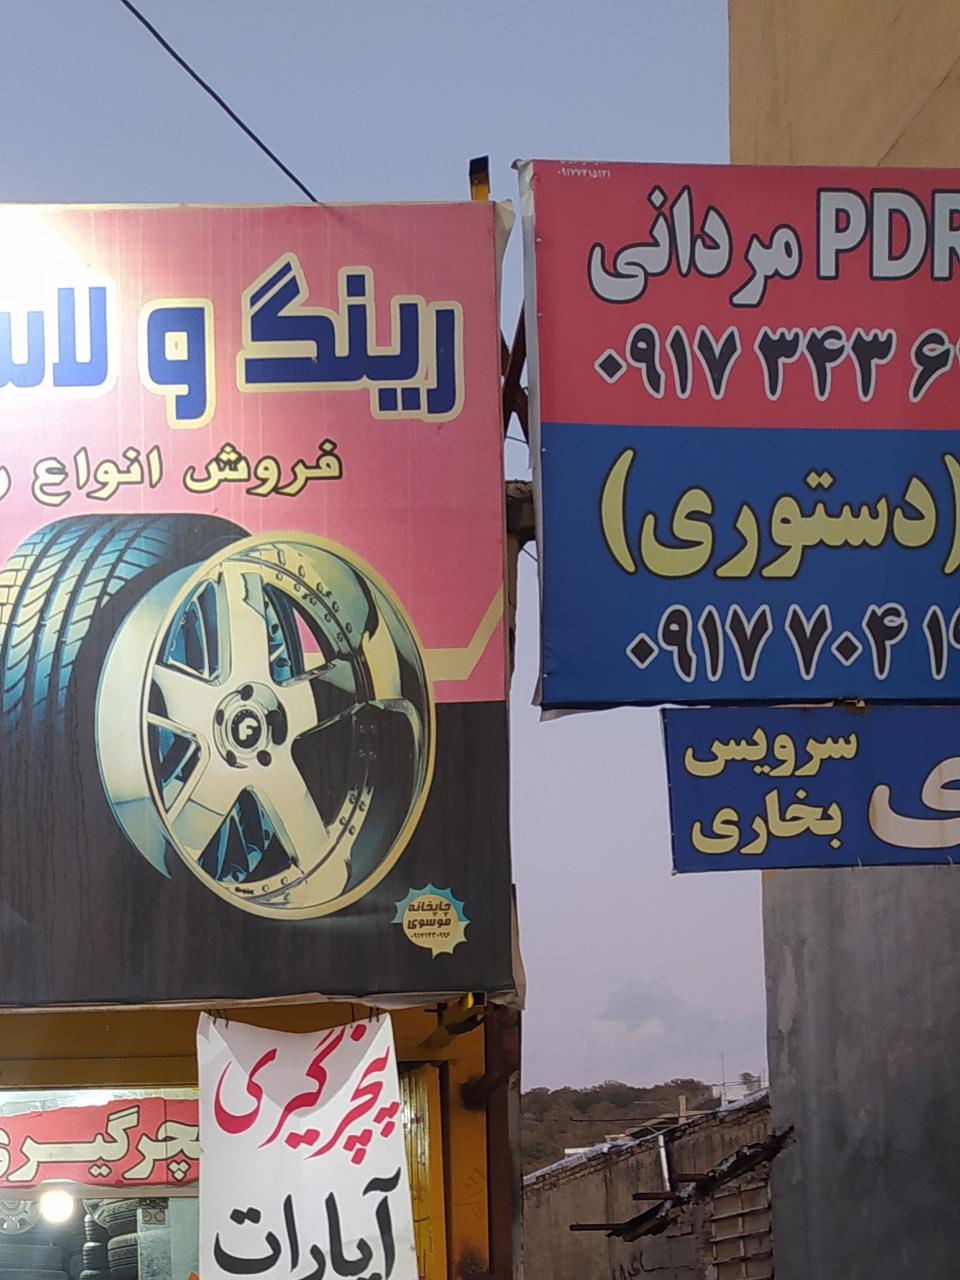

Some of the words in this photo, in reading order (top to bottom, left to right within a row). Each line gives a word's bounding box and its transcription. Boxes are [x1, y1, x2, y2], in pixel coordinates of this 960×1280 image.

[588, 185, 802, 308] مردانی
[145, 303, 210, 423] و
[241, 258, 458, 416] رینگ
[909, 327, 960, 402] ۶
[32, 444, 162, 507] انواع
[184, 437, 343, 496] فروش
[684, 726, 858, 777] سرویس
[691, 788, 844, 855] بخاری
[214, 1023, 401, 1165] پنچرگیری
